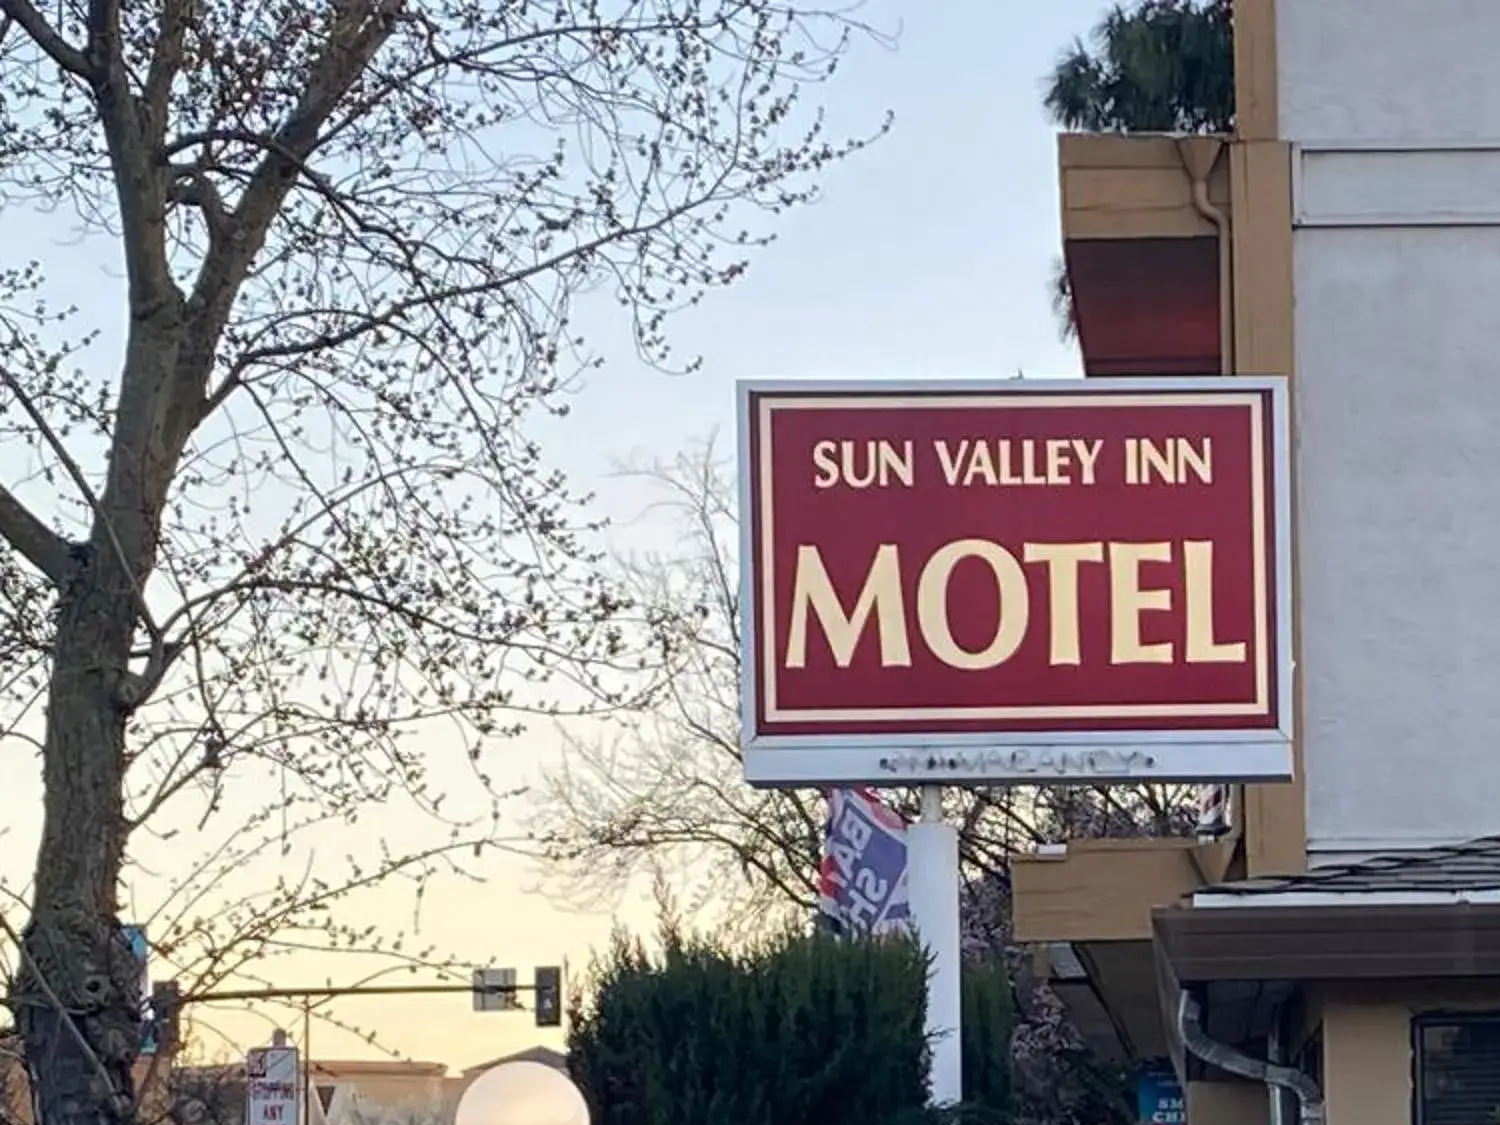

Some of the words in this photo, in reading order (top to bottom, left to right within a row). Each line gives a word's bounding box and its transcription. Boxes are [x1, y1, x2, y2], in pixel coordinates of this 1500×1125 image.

[813, 440, 914, 489] SUN
[935, 439, 1104, 486] VALLEY
[1125, 437, 1212, 484] INN
[785, 538, 1248, 671] MOTEL
[263, 1103, 284, 1121] ANY
